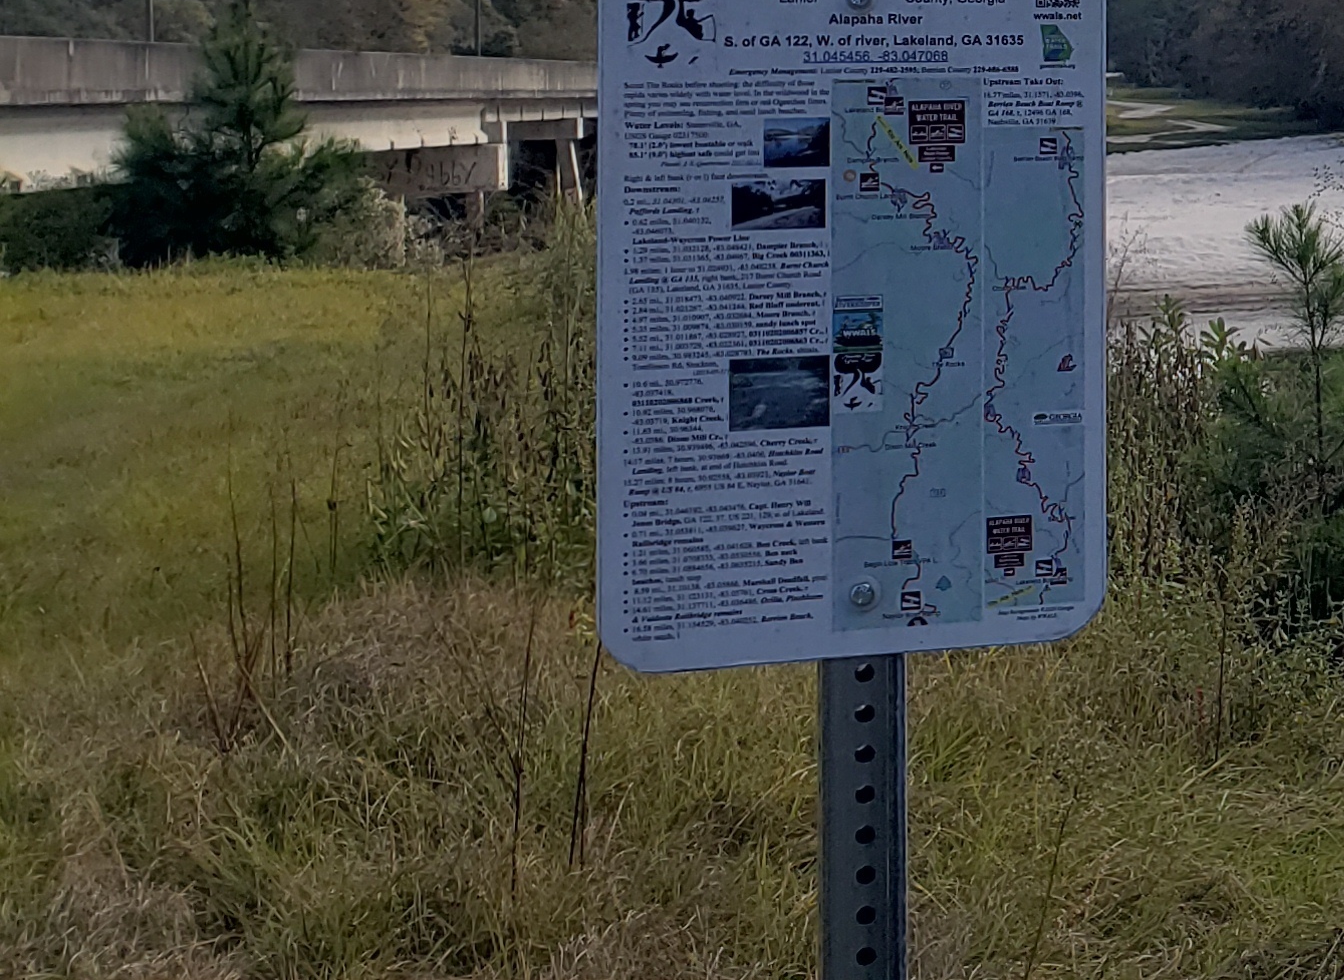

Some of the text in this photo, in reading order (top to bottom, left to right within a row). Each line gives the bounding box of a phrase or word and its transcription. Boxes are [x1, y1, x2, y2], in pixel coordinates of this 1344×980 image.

[828, 13, 923, 27] Alapaha River
[1033, 11, 1082, 20] wwals.net
[724, 35, 1024, 49] S. of GA 122, W. of river, Lakeland, GA 31635
[878, 50, 948, 63] -83.047068
